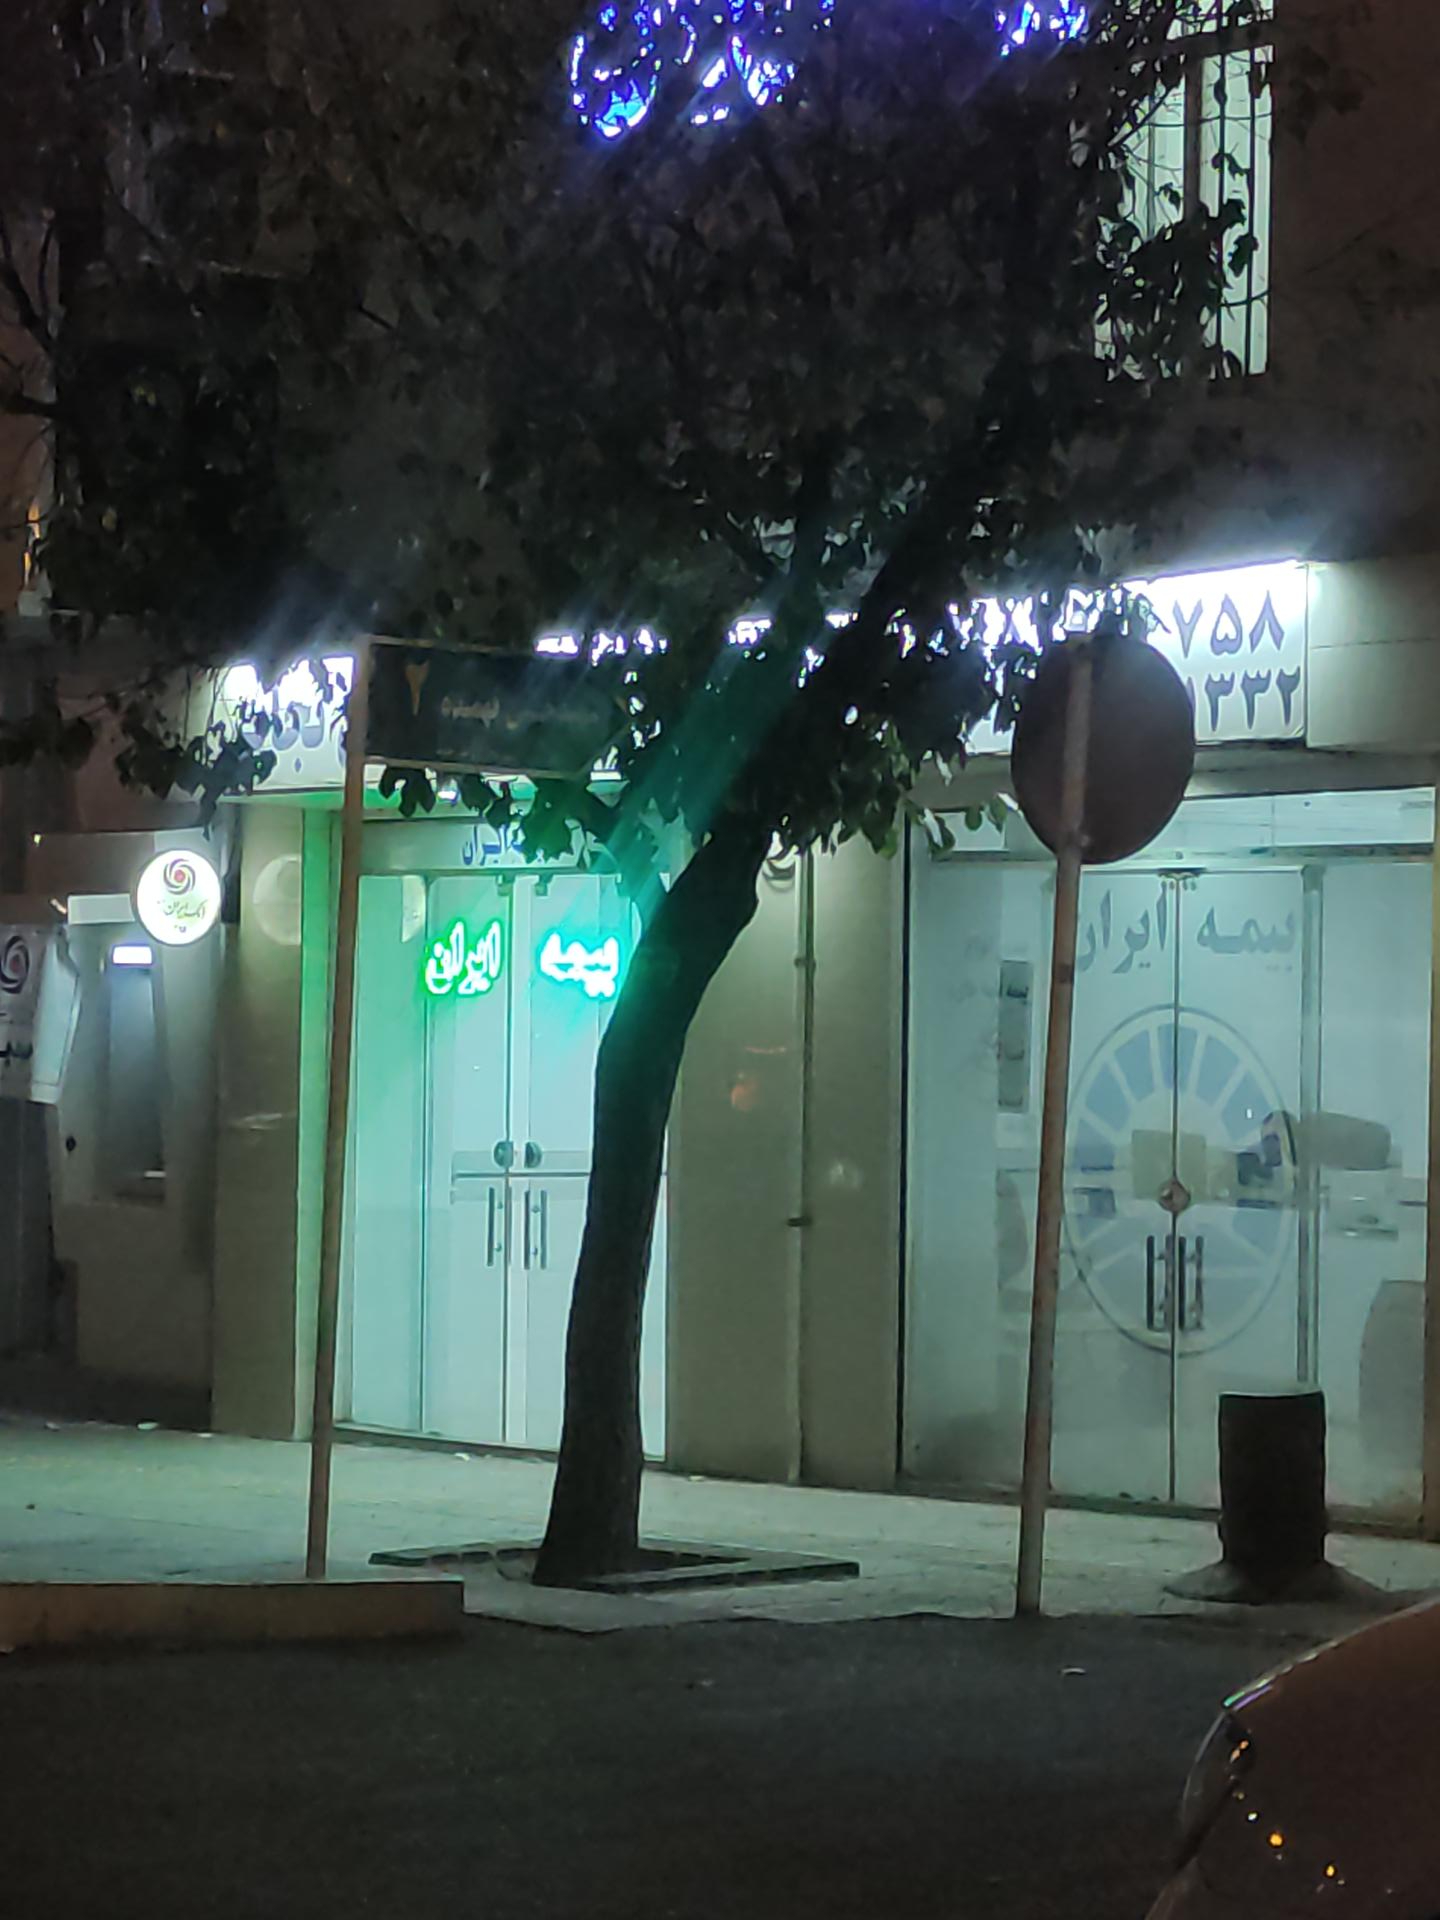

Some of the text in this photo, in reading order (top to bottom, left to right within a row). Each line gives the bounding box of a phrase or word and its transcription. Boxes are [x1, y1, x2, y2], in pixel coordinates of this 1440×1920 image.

[1172, 589, 1285, 660] ۷۵۸
[425, 920, 620, 997] بیمه ایران
[1196, 906, 1298, 973] بیمه
